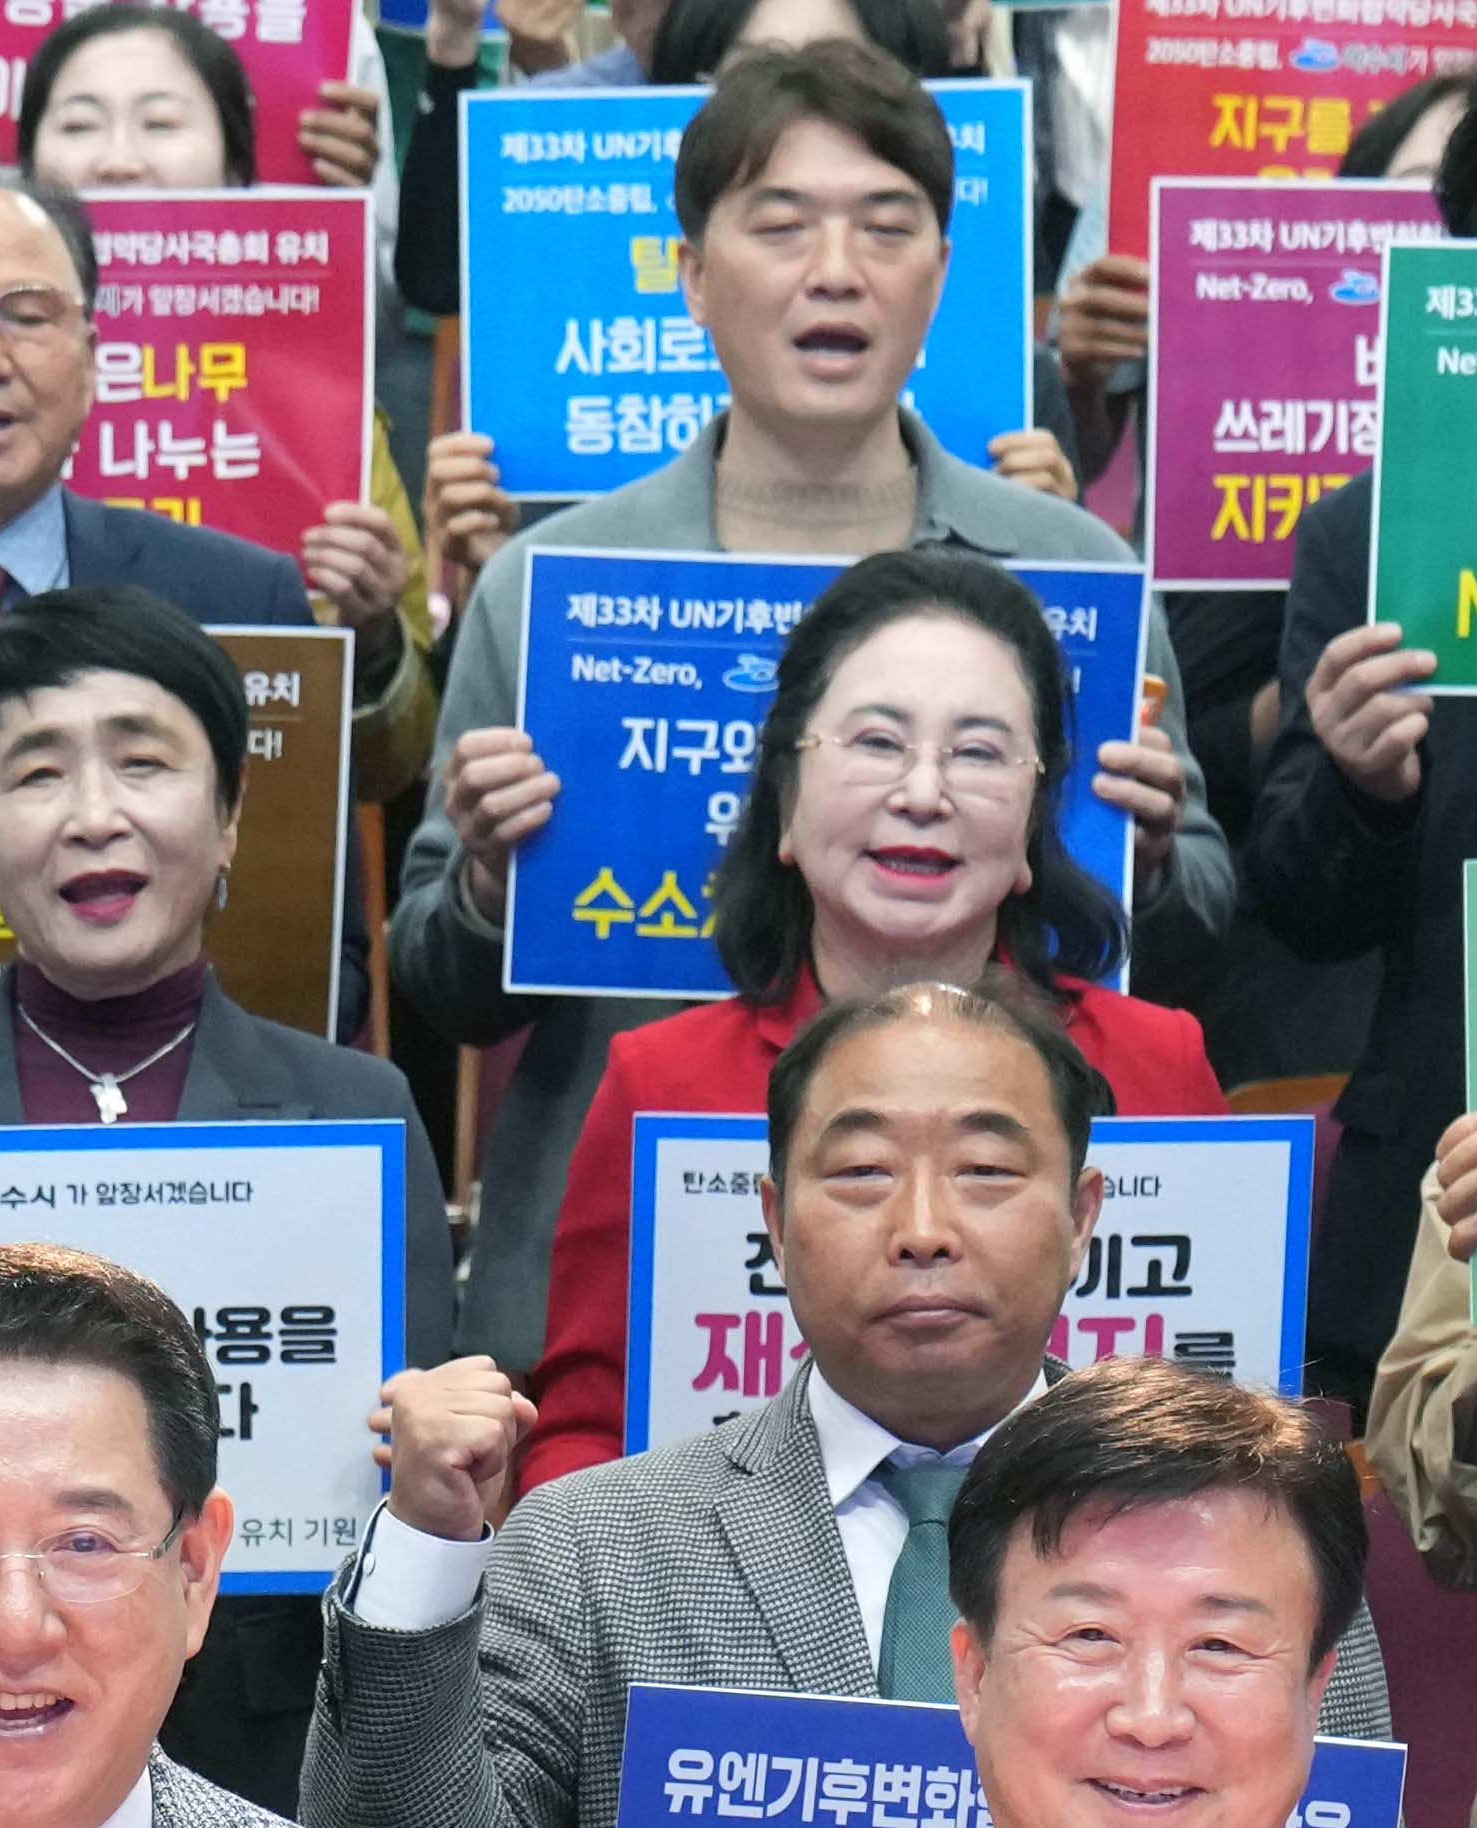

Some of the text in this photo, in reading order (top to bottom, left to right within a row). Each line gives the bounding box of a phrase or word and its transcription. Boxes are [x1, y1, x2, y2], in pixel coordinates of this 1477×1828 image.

[1209, 94, 1352, 155] 지구를
[1189, 218, 1273, 253] 제33차
[1197, 274, 1313, 305] Net-Zero,
[99, 421, 261, 480] 나누는
[567, 594, 663, 630] 제33차
[571, 655, 703, 690] Net-Zero,
[70, 1182, 87, 1207] 가
[95, 1180, 253, 1206] 앞장서겠습니다
[240, 1518, 358, 1547] 유치 기원
